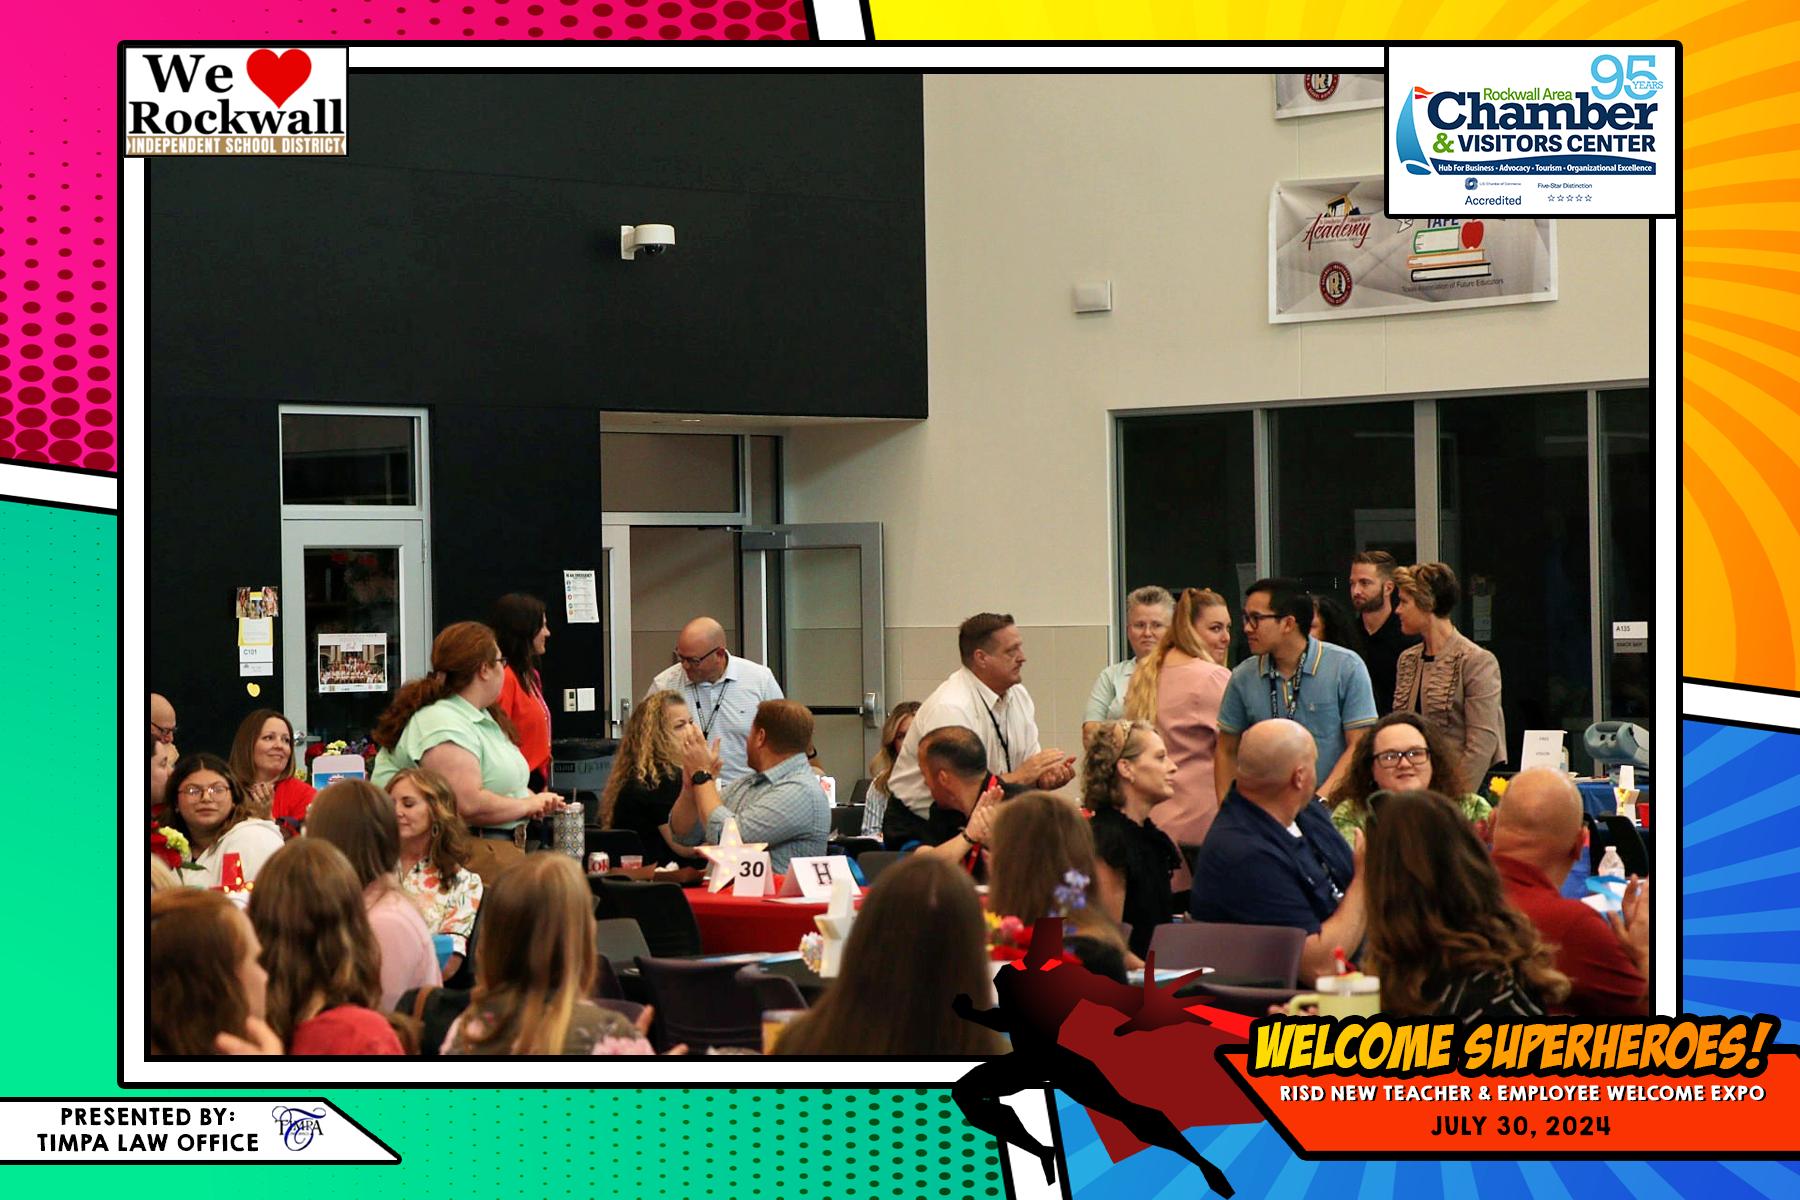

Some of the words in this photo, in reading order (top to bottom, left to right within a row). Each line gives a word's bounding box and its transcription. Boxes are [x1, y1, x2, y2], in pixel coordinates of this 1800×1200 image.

[1302, 213, 1371, 250] Academy
[739, 861, 765, 878] 30
[812, 862, 832, 885] H
